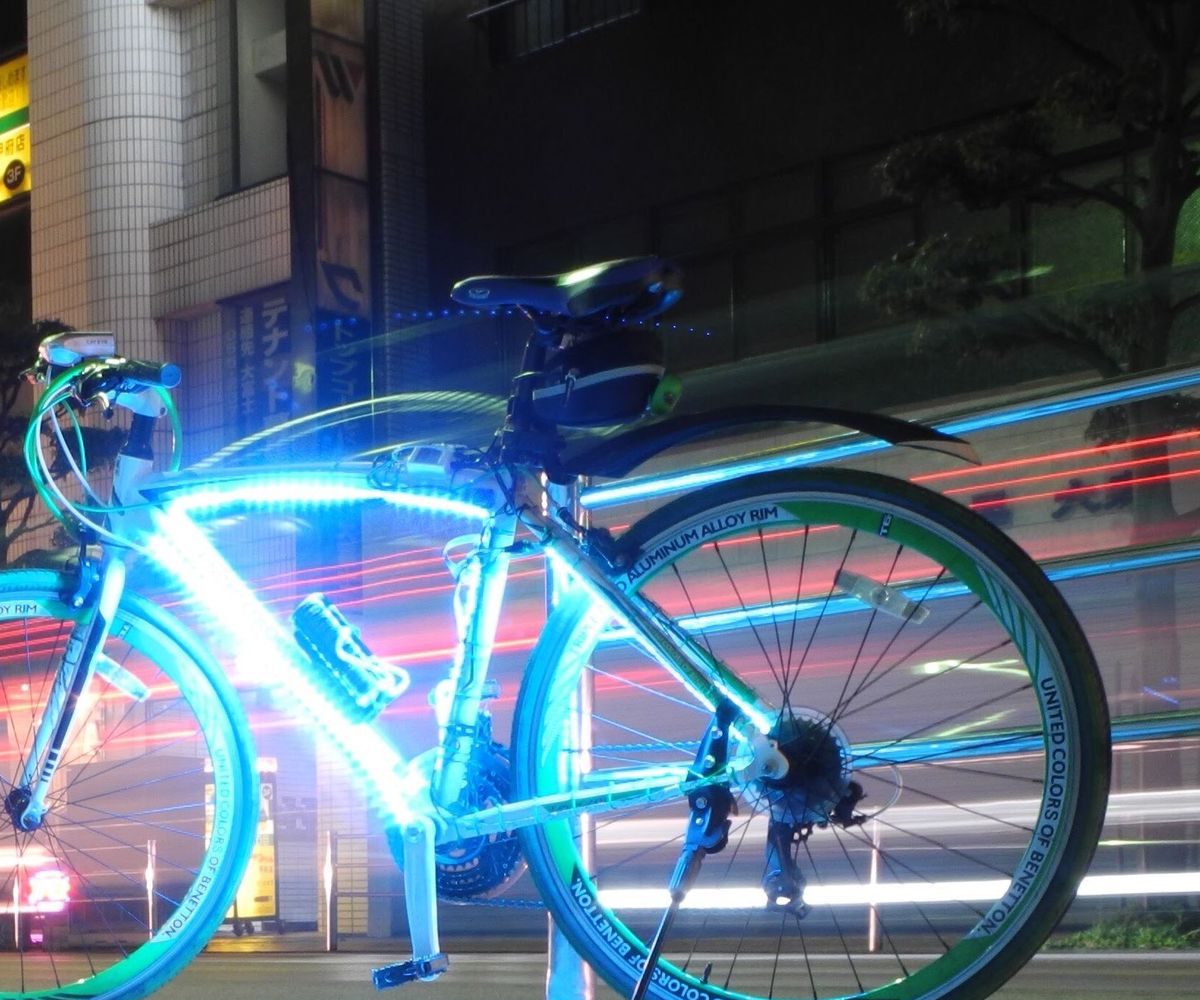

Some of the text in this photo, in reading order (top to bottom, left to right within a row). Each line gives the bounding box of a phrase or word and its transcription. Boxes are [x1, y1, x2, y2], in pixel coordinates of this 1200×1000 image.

[6, 165, 22, 184] 3F
[627, 506, 779, 584] ALUMINUM ALLOY RIM
[14, 603, 37, 614] RIM
[1041, 677, 1065, 746] UNITED
[215, 750, 231, 798] UNITED
[1044, 748, 1066, 821] COLORS
[215, 800, 231, 852] COLORS
[1037, 824, 1054, 849] OF
[208, 856, 219, 876] OF
